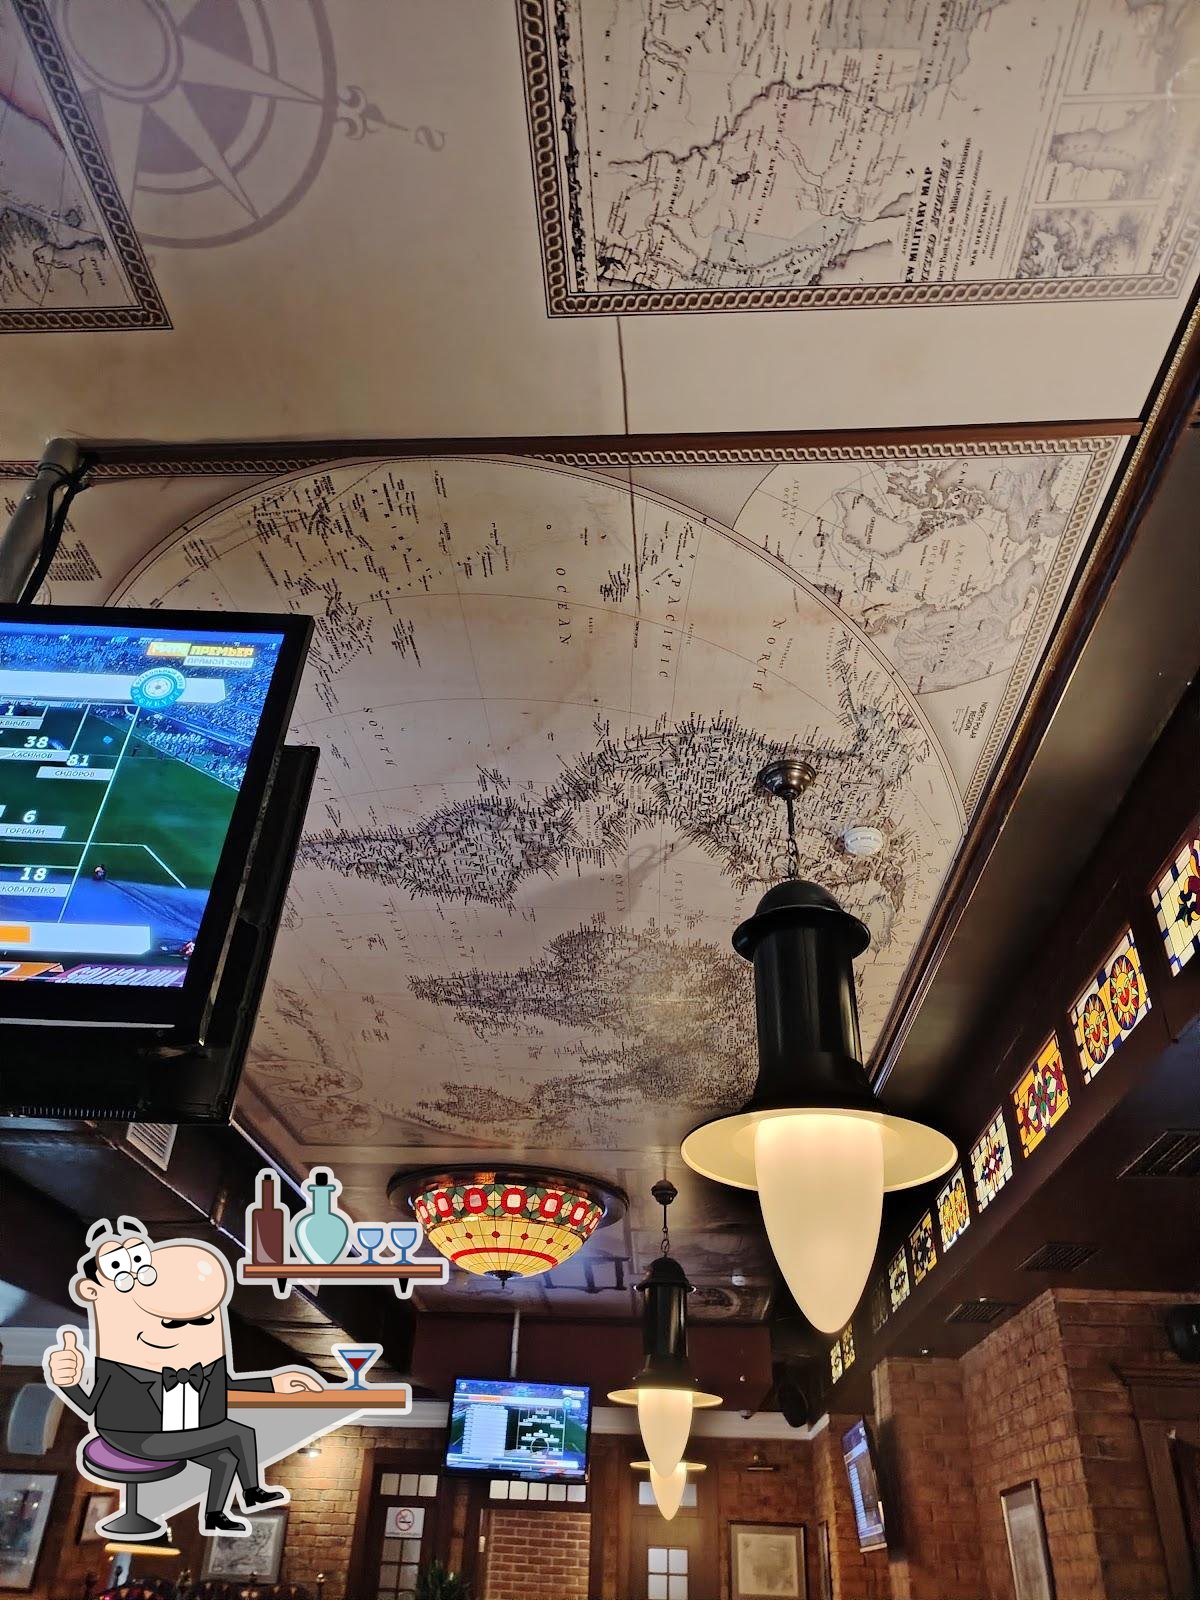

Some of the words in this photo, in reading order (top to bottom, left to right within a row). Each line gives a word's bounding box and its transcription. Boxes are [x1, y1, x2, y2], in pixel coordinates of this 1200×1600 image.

[955, 136, 973, 180] Divisions
[920, 166, 934, 197] MAP
[948, 180, 963, 214] Military
[908, 200, 928, 262] MILITARY
[905, 265, 916, 284] EW
[555, 566, 573, 646] OCEAN
[657, 576, 683, 680] PACIFIC
[190, 645, 255, 657] ПРЕМЬЕР
[752, 616, 788, 694] NORTH
[5, 705, 14, 716] 1
[24, 735, 49, 748] 38
[362, 706, 398, 768] SOUTH
[11, 751, 53, 759] КАСИМОВ
[66, 753, 90, 767] 81
[54, 769, 95, 778] СИДОРОВ
[23, 809, 37, 823] 6
[20, 867, 47, 881] 18
[1, 885, 56, 894] КОВАЛЕНКО
